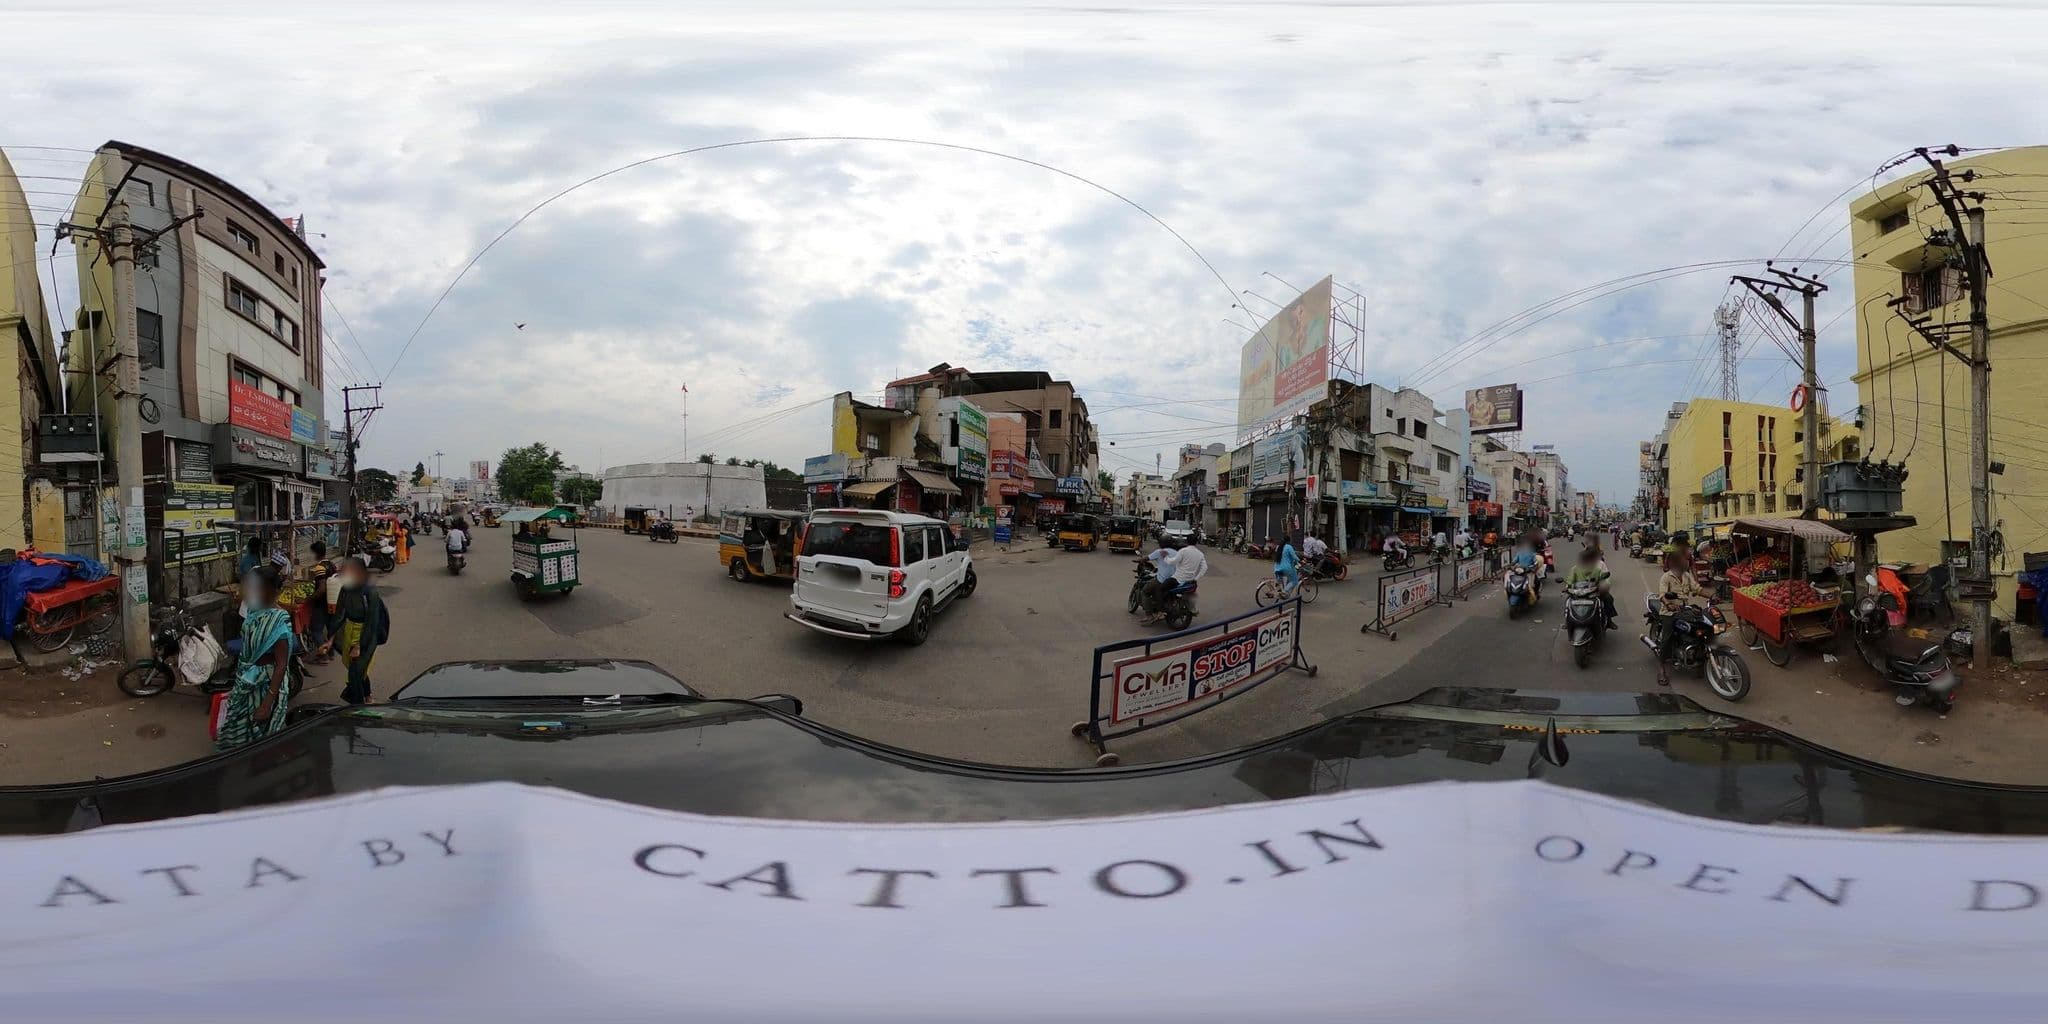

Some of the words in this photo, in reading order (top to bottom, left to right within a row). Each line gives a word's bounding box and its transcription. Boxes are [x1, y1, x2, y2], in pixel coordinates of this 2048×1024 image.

[1410, 583, 1428, 602] STOP
[1259, 620, 1290, 647] CMR
[1193, 639, 1256, 681] STOP
[1124, 660, 1187, 695] CMR
[1127, 682, 1185, 702] JEWELLERY
[41, 856, 306, 907] ATA
[361, 828, 462, 869] BY
[632, 818, 1386, 909] CATTO.IN
[1534, 834, 1859, 907] OPEN
[1963, 878, 2044, 911] D
